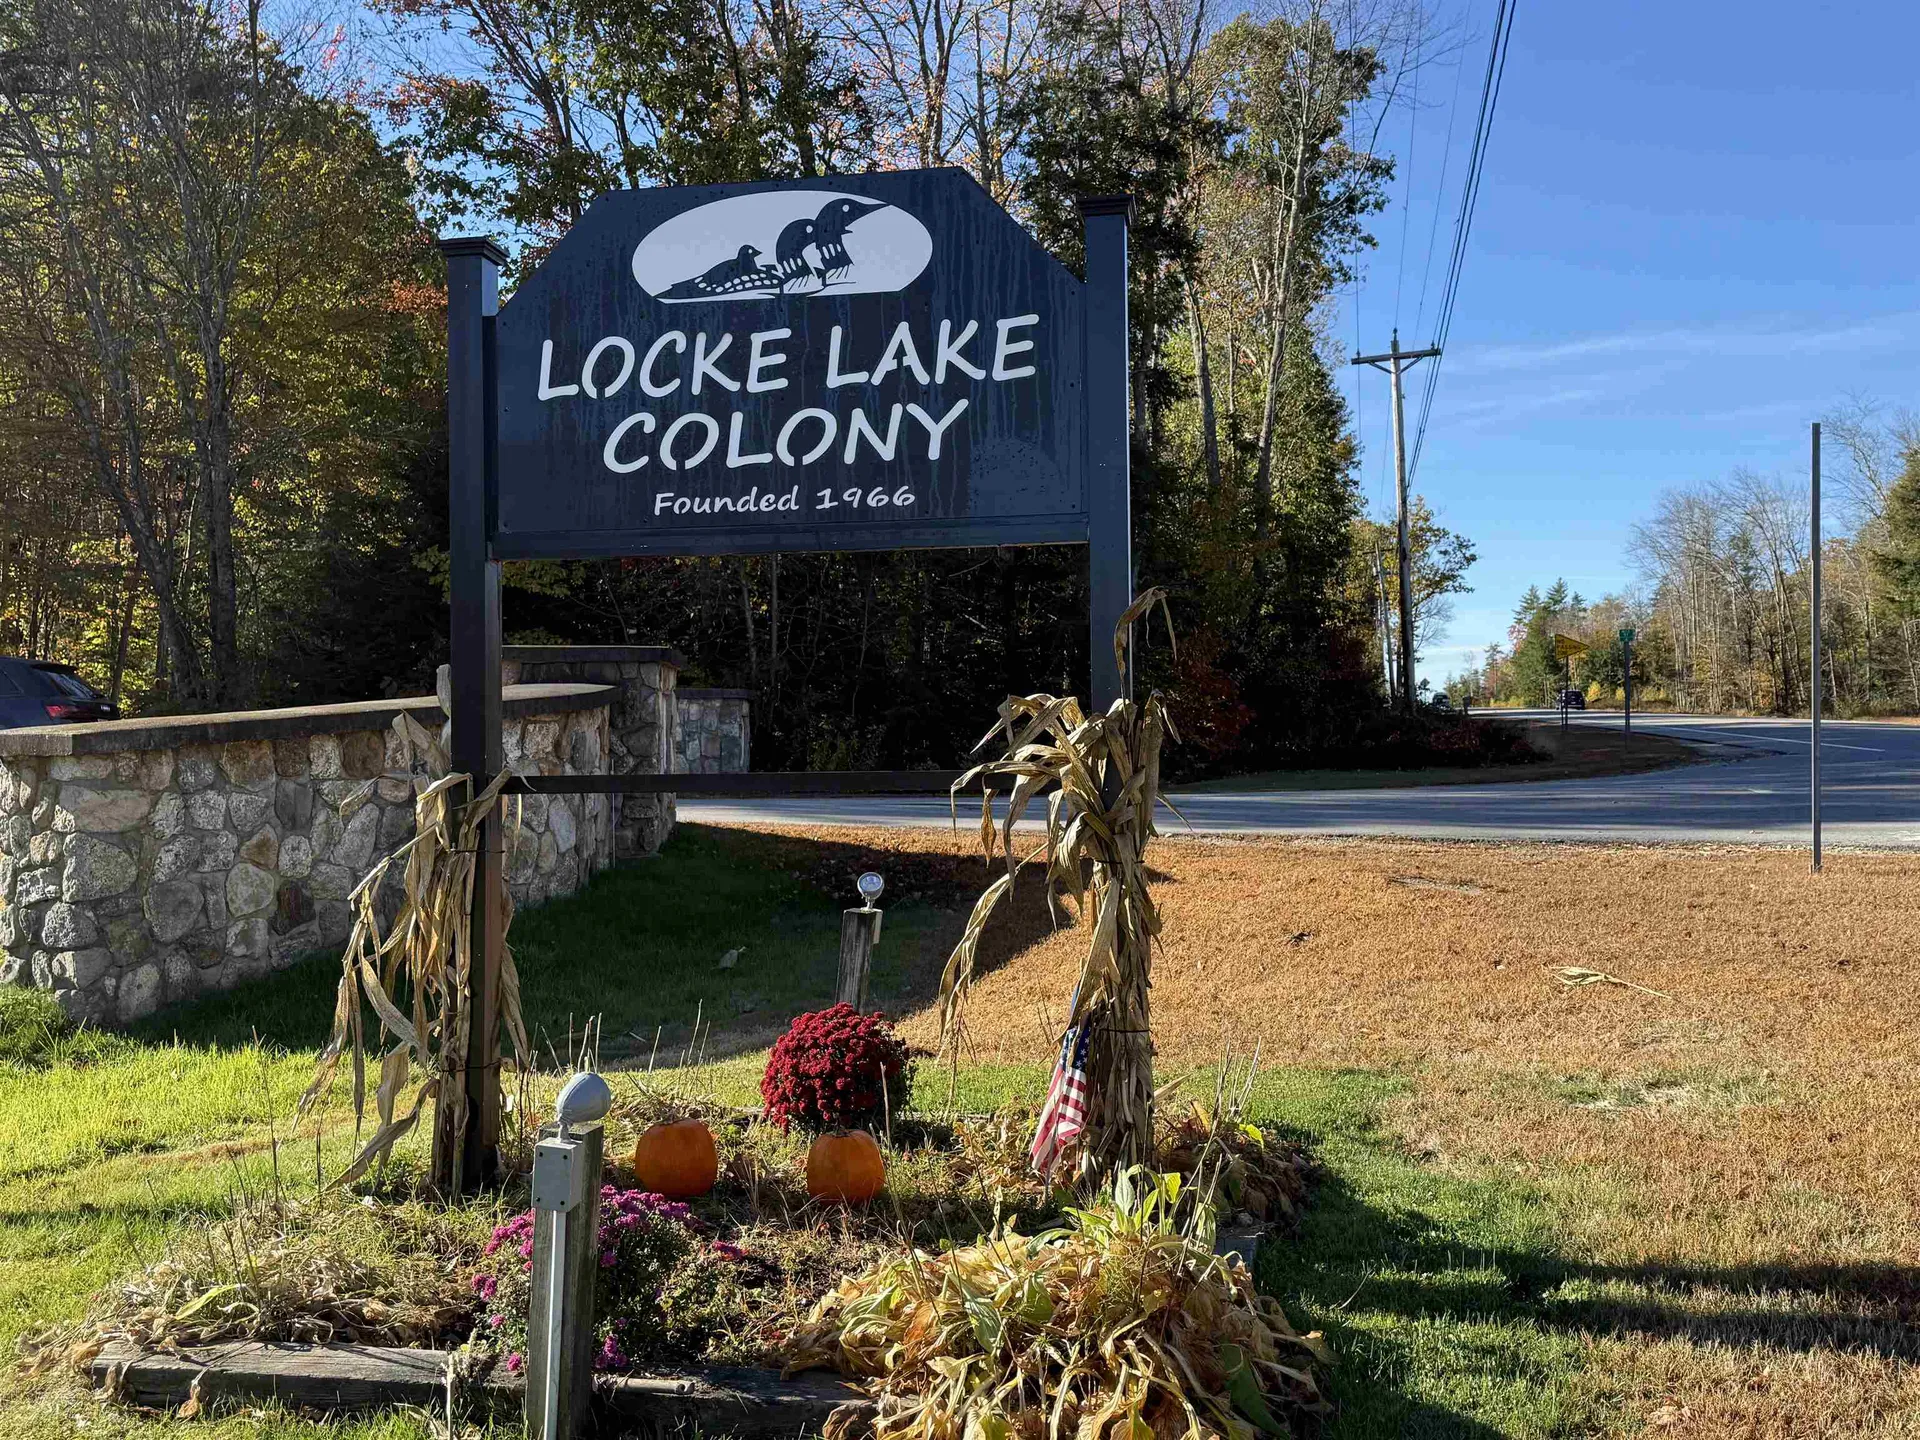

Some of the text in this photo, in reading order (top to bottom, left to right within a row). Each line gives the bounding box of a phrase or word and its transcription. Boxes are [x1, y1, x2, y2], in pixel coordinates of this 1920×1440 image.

[538, 314, 1039, 400] LOCKE LAKE
[604, 399, 968, 473] COLONY
[653, 485, 915, 515] Founded 1966
